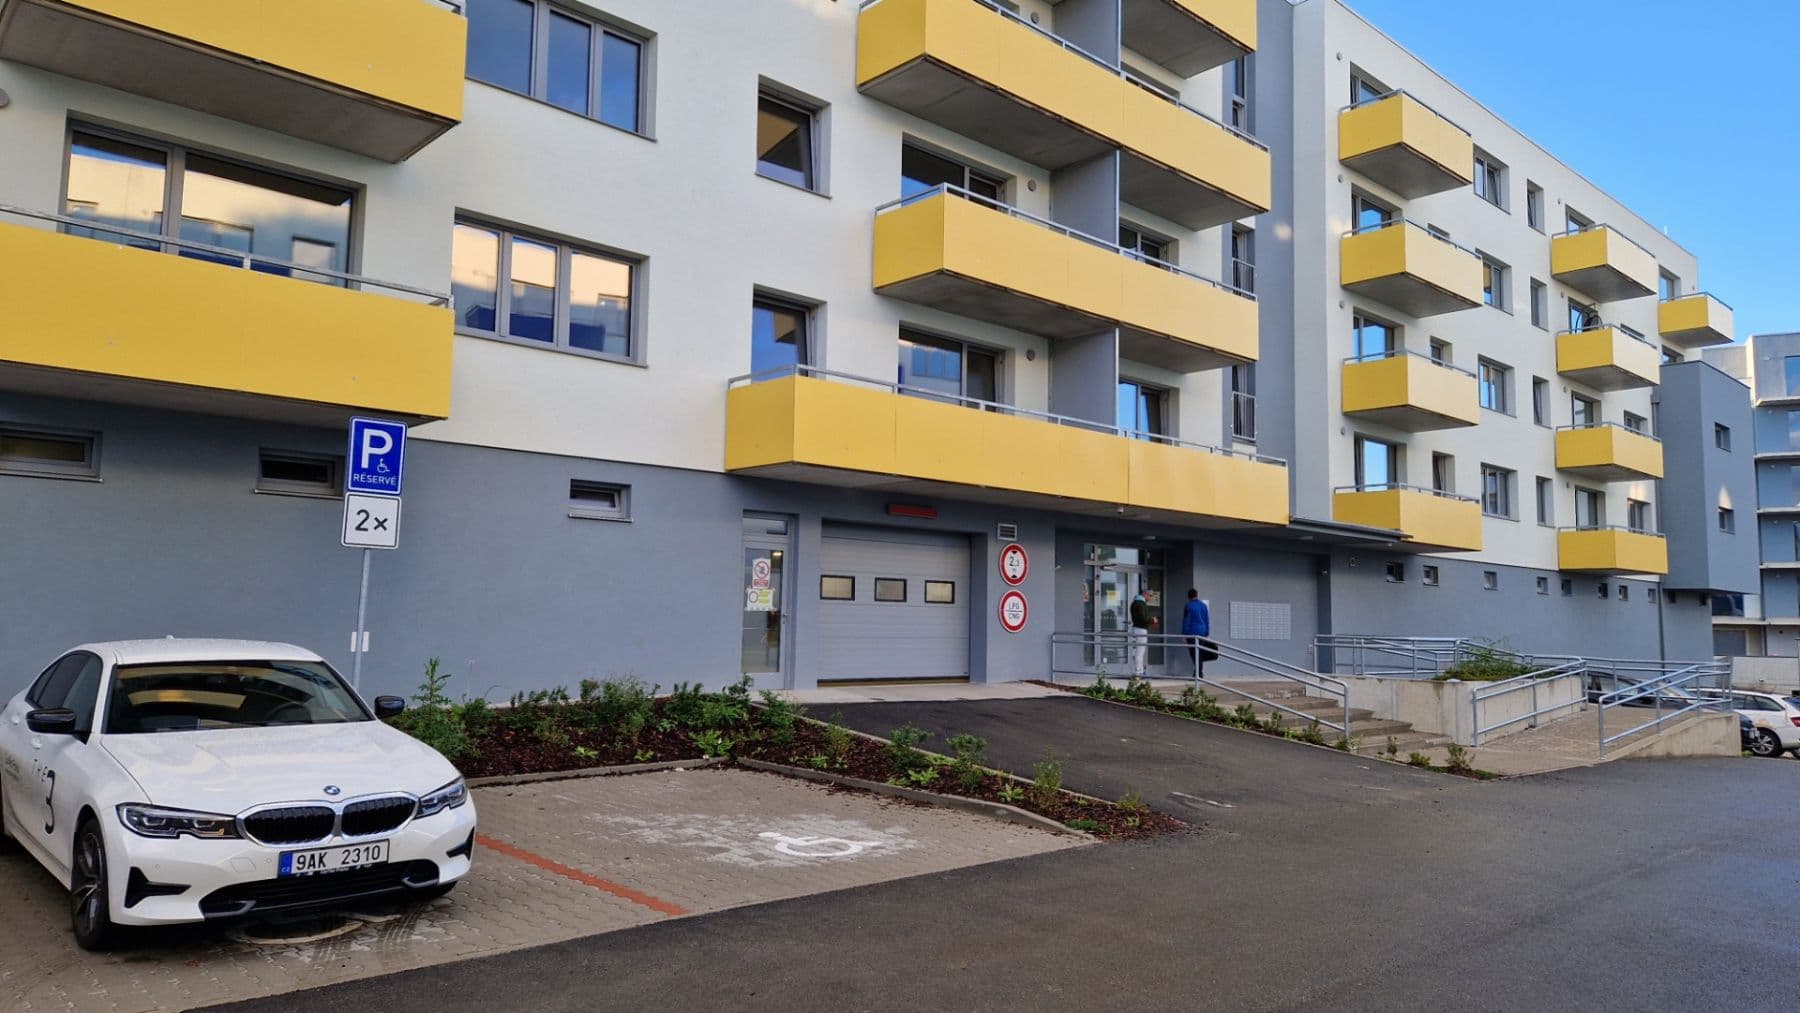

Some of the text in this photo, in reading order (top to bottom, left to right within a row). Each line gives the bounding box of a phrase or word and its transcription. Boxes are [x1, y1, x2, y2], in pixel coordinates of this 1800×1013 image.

[361, 428, 393, 469] P
[296, 851, 328, 870] 9AK
[341, 845, 381, 865] 2310
